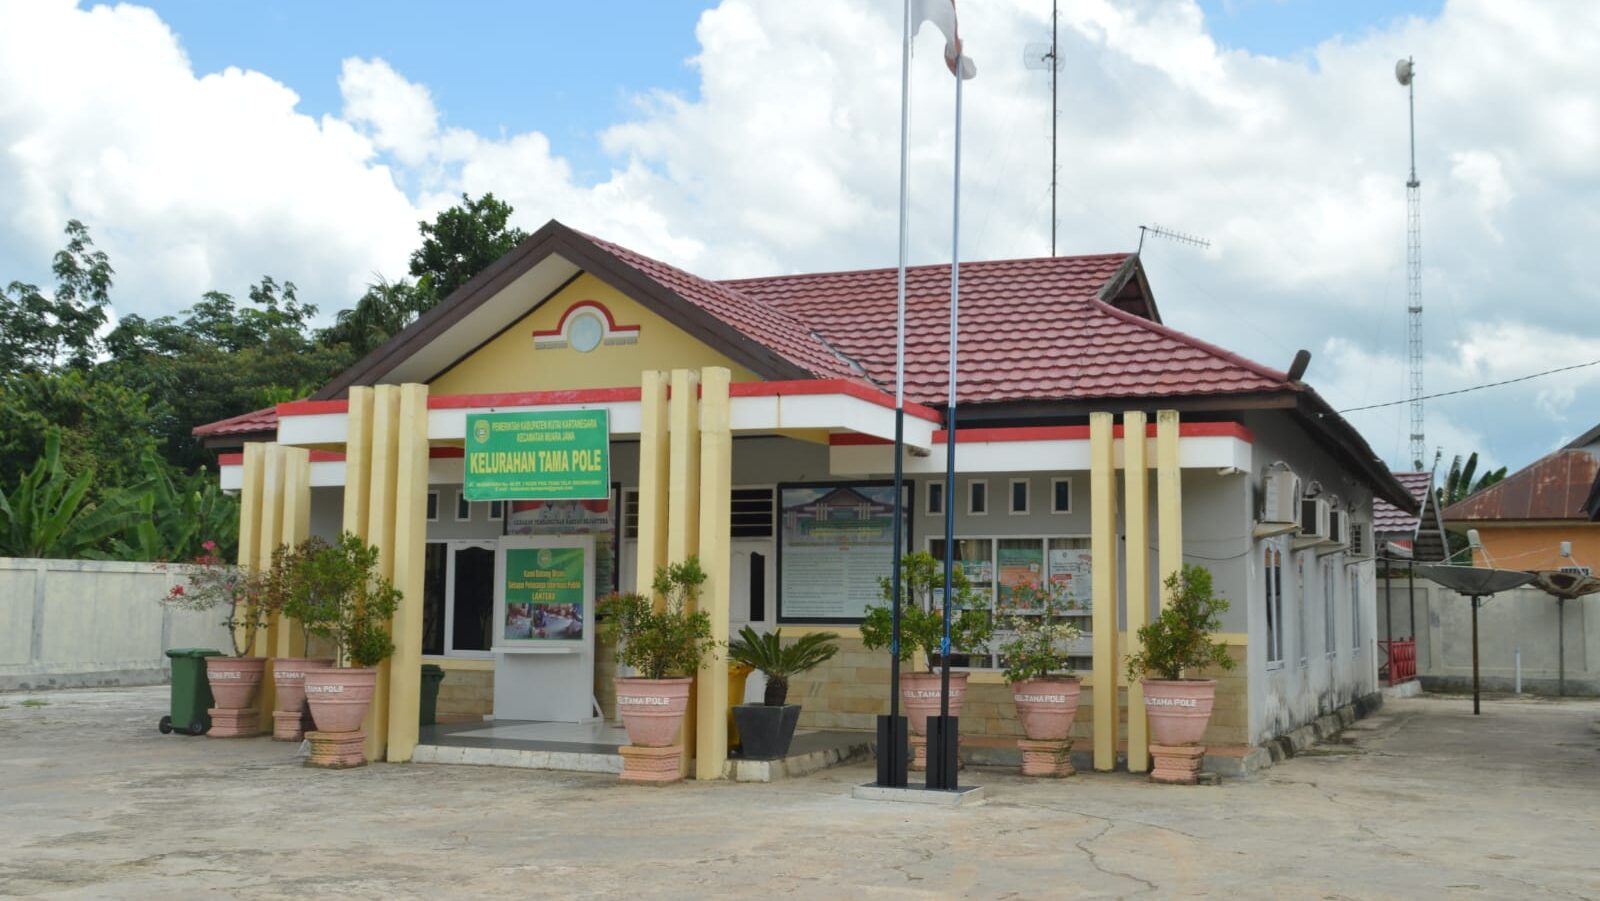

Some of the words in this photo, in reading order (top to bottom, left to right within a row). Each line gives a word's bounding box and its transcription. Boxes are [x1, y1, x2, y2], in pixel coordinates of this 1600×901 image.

[520, 421, 545, 430] KABUPATEN
[517, 433, 545, 442] KECAMATAN
[470, 451, 536, 474] KELURAHAN
[539, 450, 569, 472] TAMA
[572, 449, 602, 471] POLE
[645, 697, 671, 705] POLE
[1174, 698, 1197, 707] POLE
